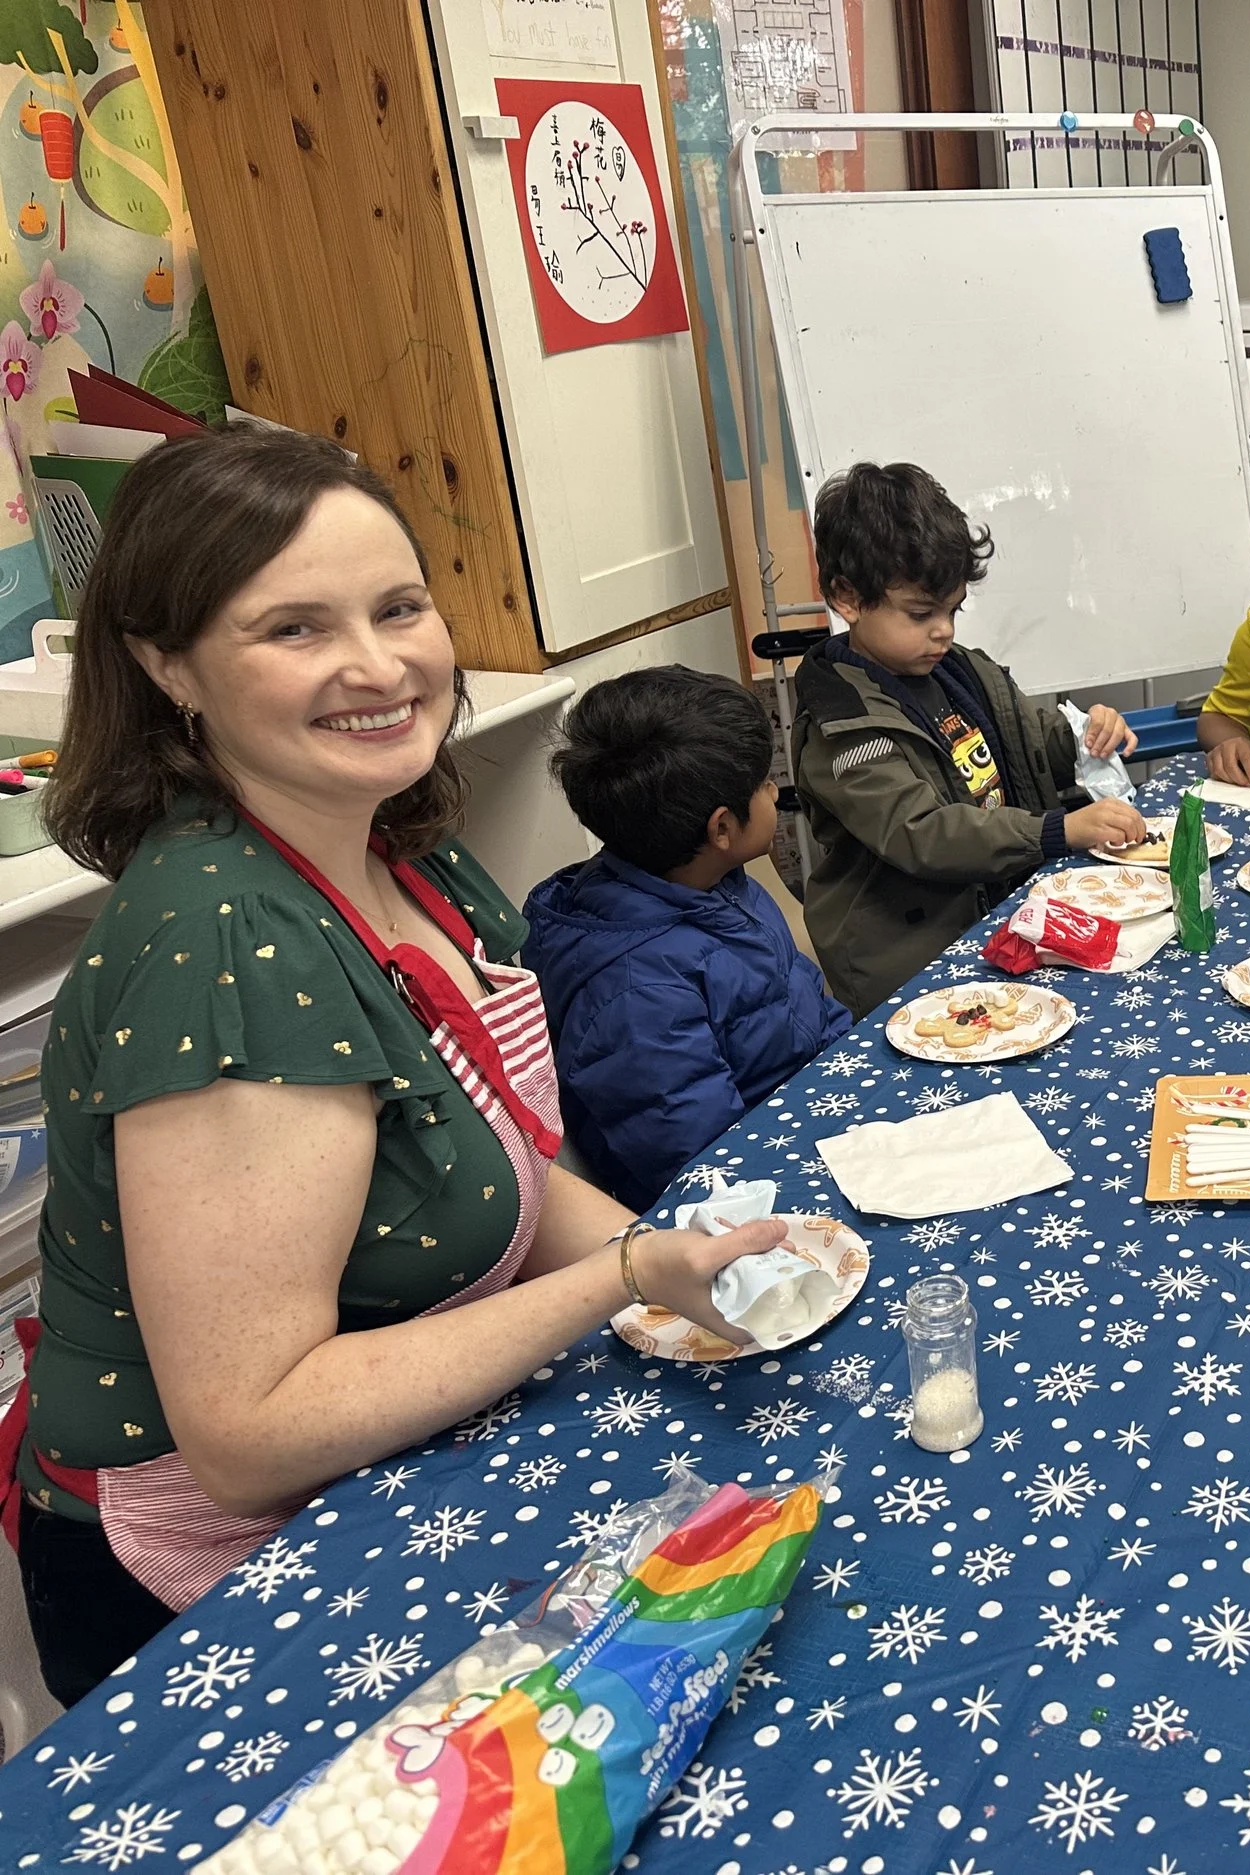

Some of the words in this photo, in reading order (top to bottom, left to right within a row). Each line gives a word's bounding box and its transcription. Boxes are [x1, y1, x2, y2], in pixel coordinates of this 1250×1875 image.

[590, 117, 607, 170] 梅花
[1018, 907, 1034, 925] RED
[554, 1595, 640, 1690] marshmallows
[640, 1649, 729, 1776] Jet-Puffed
[650, 1696, 664, 1712] LB
[647, 1758, 669, 1799] mini
